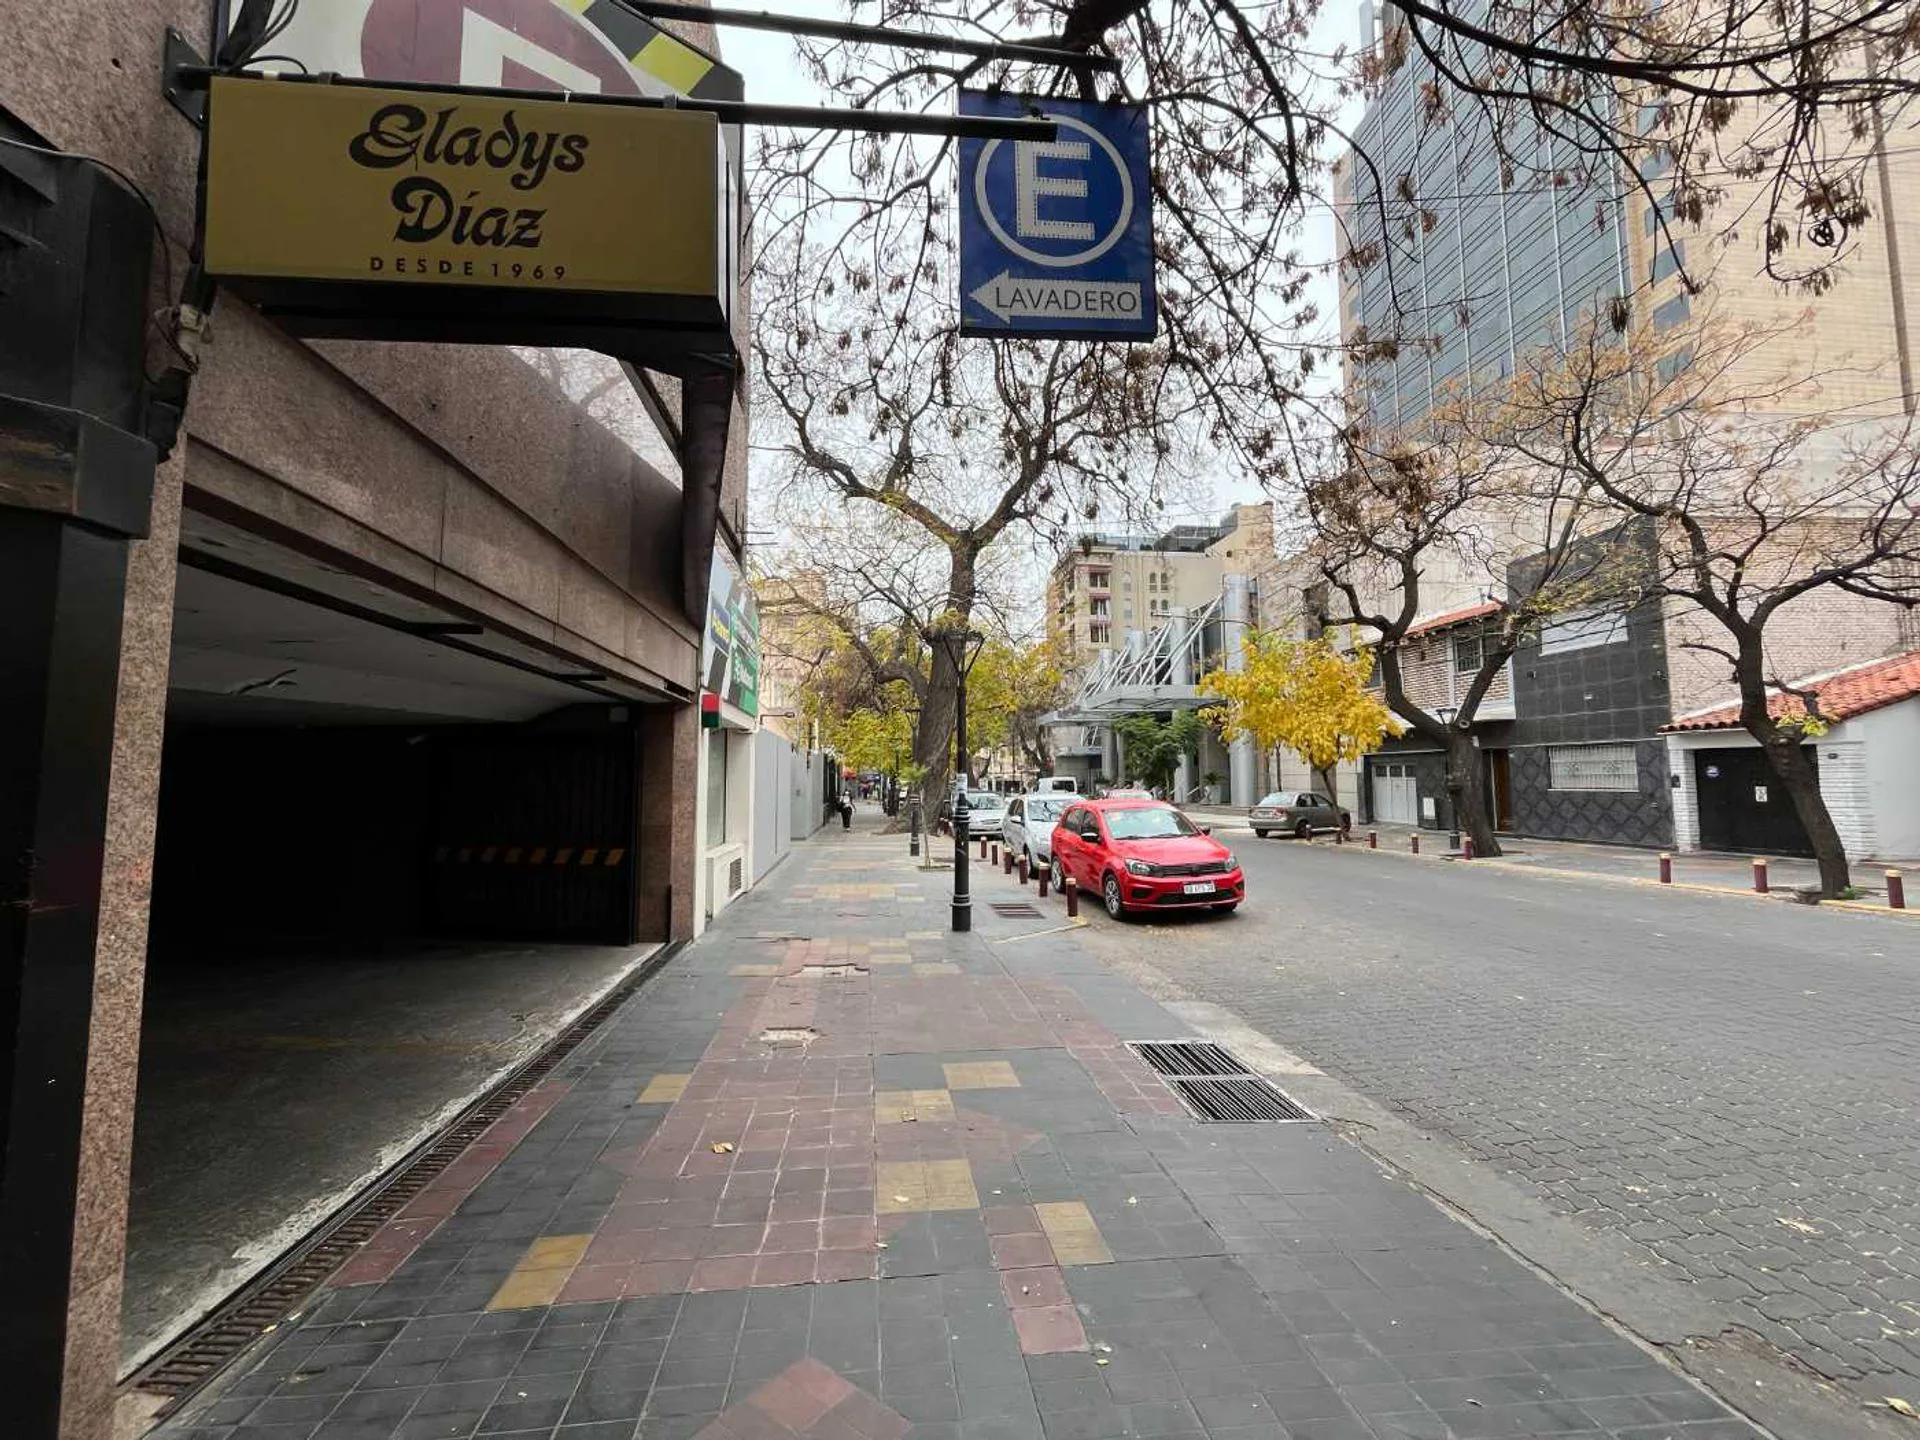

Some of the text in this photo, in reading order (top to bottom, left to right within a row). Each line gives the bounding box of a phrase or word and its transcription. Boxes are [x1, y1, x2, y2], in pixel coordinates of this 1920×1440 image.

[349, 103, 589, 190] Gladys
[391, 175, 547, 248] Díaz
[1015, 140, 1095, 241] E
[370, 256, 567, 280] DESDE 1969
[995, 286, 1137, 313] LAVADERO
